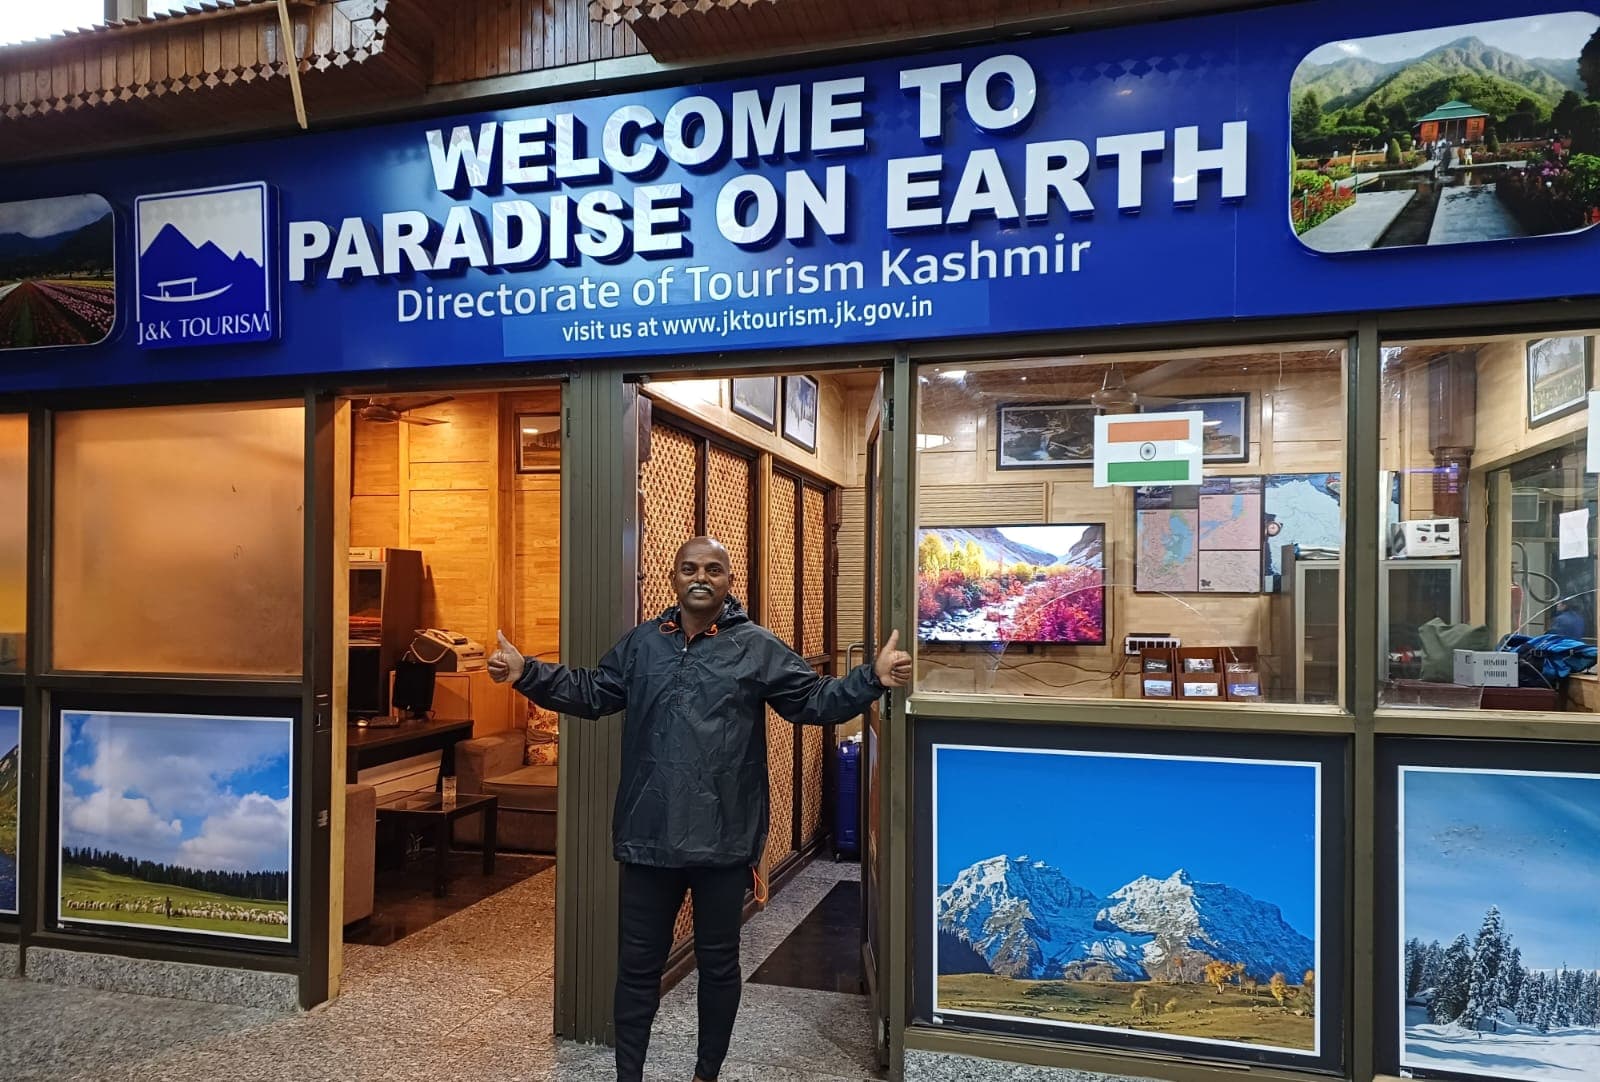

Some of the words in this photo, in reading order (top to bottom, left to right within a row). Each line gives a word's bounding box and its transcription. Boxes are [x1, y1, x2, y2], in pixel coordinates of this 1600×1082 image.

[426, 77, 865, 191] WELCOME
[900, 54, 1037, 139] TO
[288, 184, 684, 282] PARADISE
[715, 165, 846, 245] ON
[886, 120, 1248, 231] EARTH
[398, 276, 620, 322] Directorate
[633, 267, 674, 306] of
[686, 256, 864, 302] Tourism
[882, 233, 1092, 287] Kashmir
[562, 320, 605, 342] visit
[610, 323, 633, 339] us
[637, 317, 659, 338] at
[662, 295, 933, 337] www.jktourism.jk.gov.in
[137, 322, 172, 345] J&K
[178, 312, 270, 338] TOURISM
